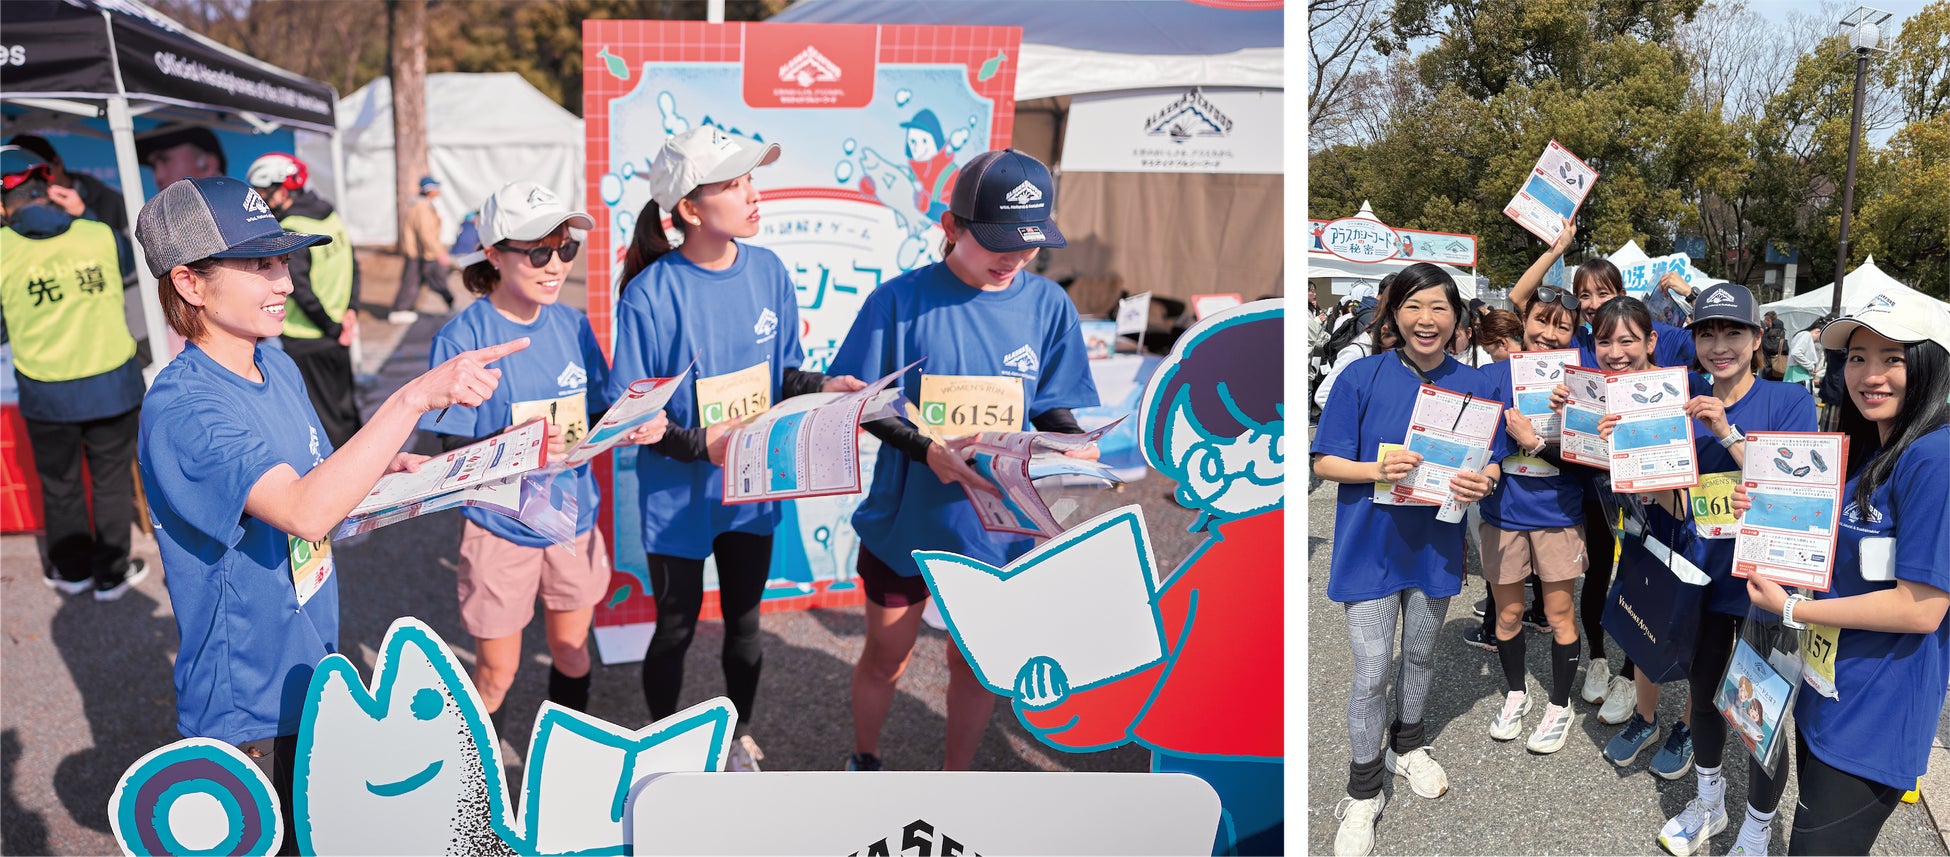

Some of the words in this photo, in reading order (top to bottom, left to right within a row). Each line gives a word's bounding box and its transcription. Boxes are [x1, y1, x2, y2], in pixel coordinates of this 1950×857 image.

[705, 404, 722, 424] C
[728, 388, 767, 420] 6156
[926, 403, 944, 424] C
[951, 404, 1014, 426] 6154
[1695, 498, 1707, 515] C
